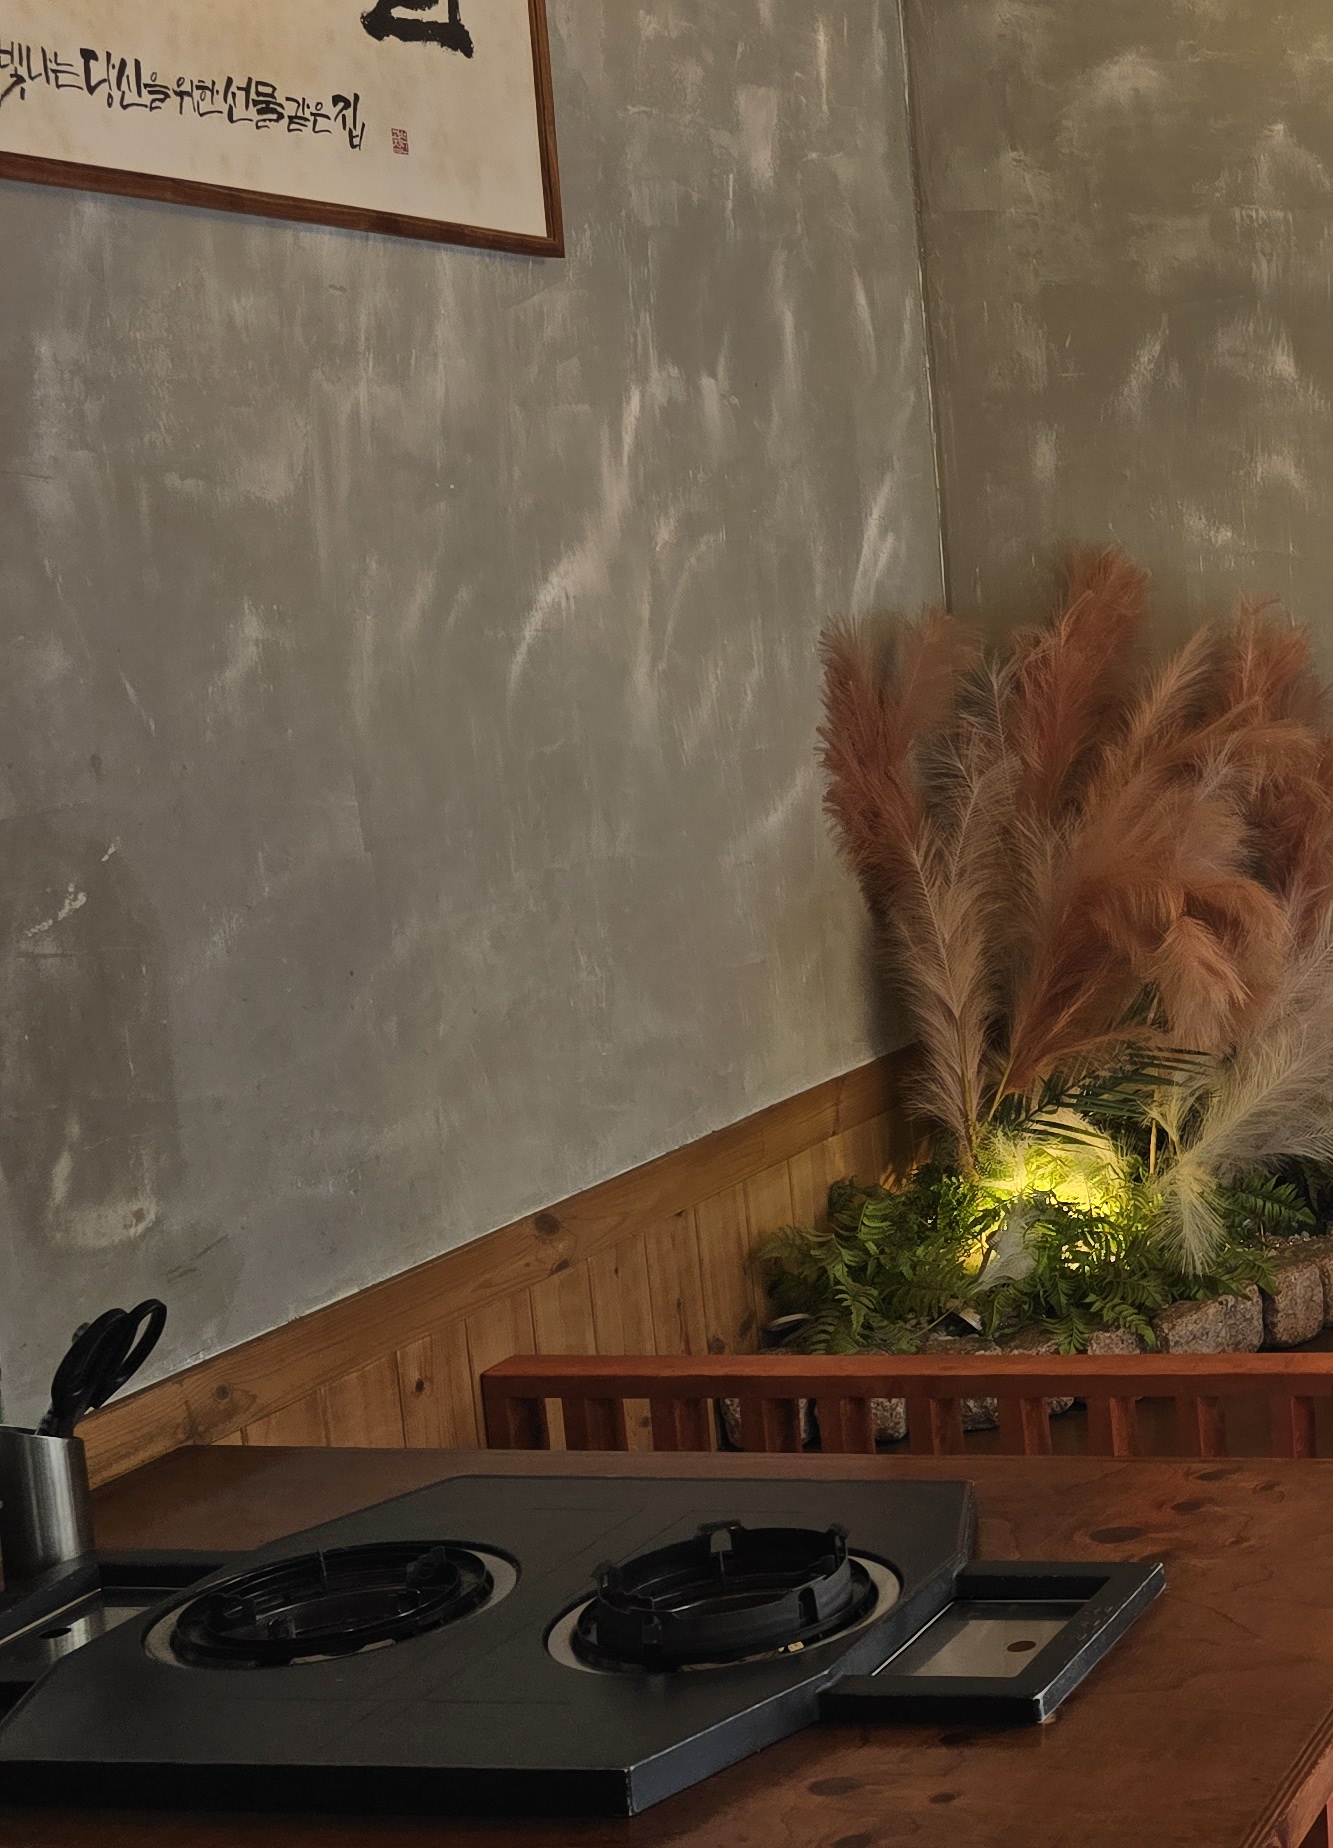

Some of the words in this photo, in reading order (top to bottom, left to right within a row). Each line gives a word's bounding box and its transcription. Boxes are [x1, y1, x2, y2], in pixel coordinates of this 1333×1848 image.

[172, 77, 223, 117] 위한
[223, 76, 286, 130] 선물
[285, 96, 333, 134] 같은
[331, 93, 366, 151] 집
